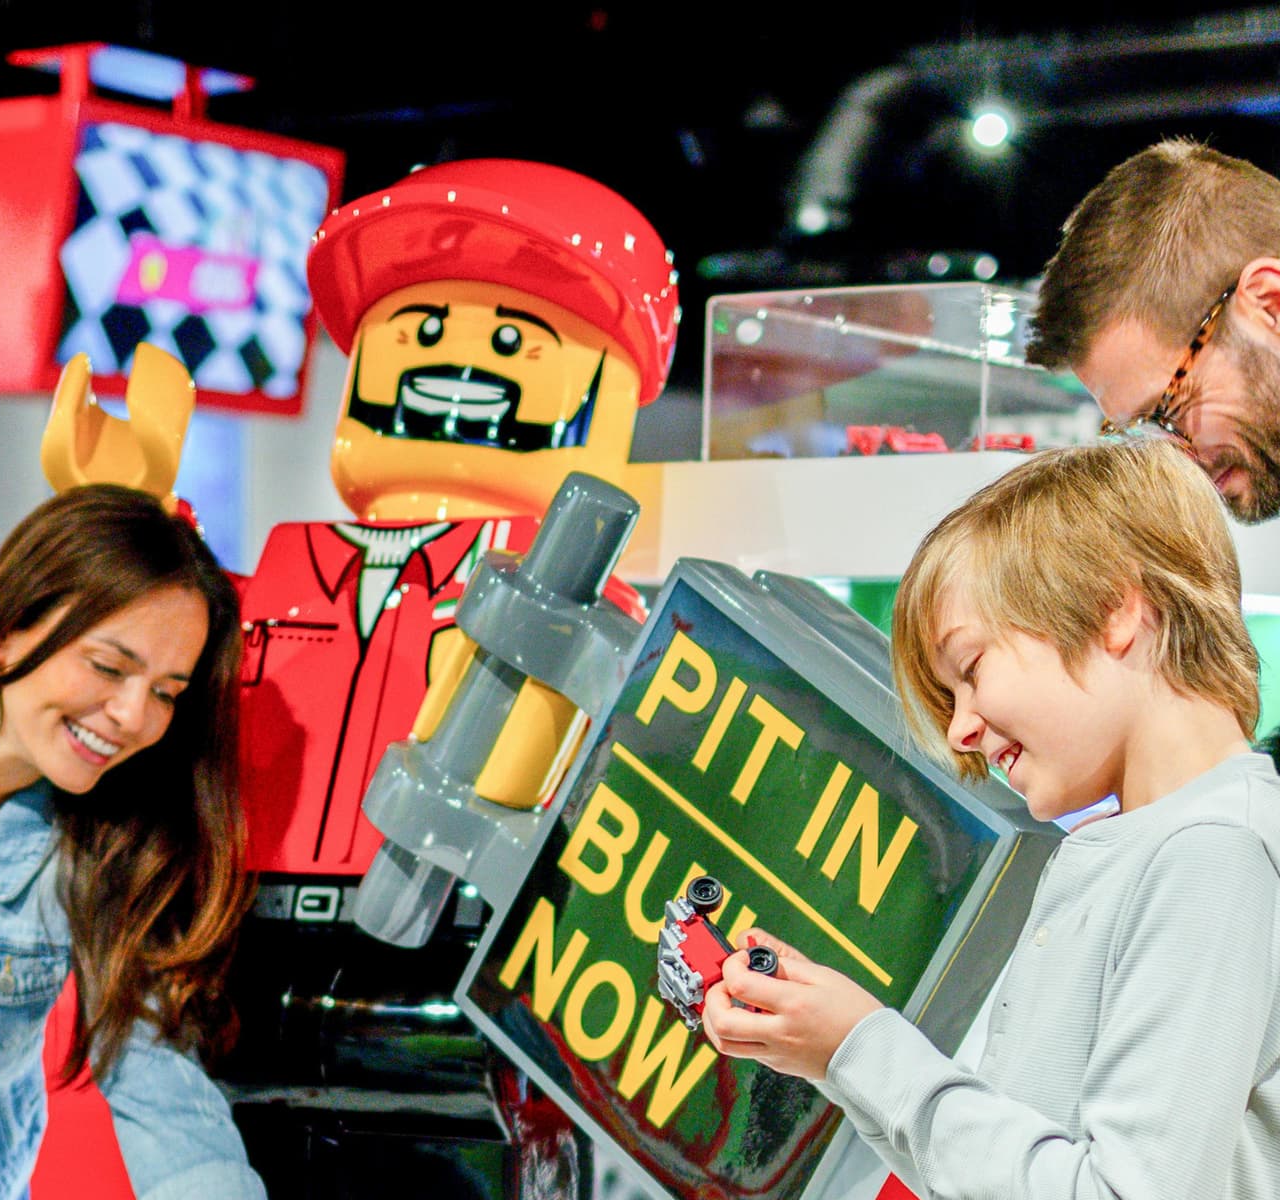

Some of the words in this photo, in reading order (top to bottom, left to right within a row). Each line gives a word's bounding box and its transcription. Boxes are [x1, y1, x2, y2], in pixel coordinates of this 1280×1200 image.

[635, 631, 805, 805] PIT
[795, 762, 919, 914] IN
[499, 897, 718, 1128] NOW
